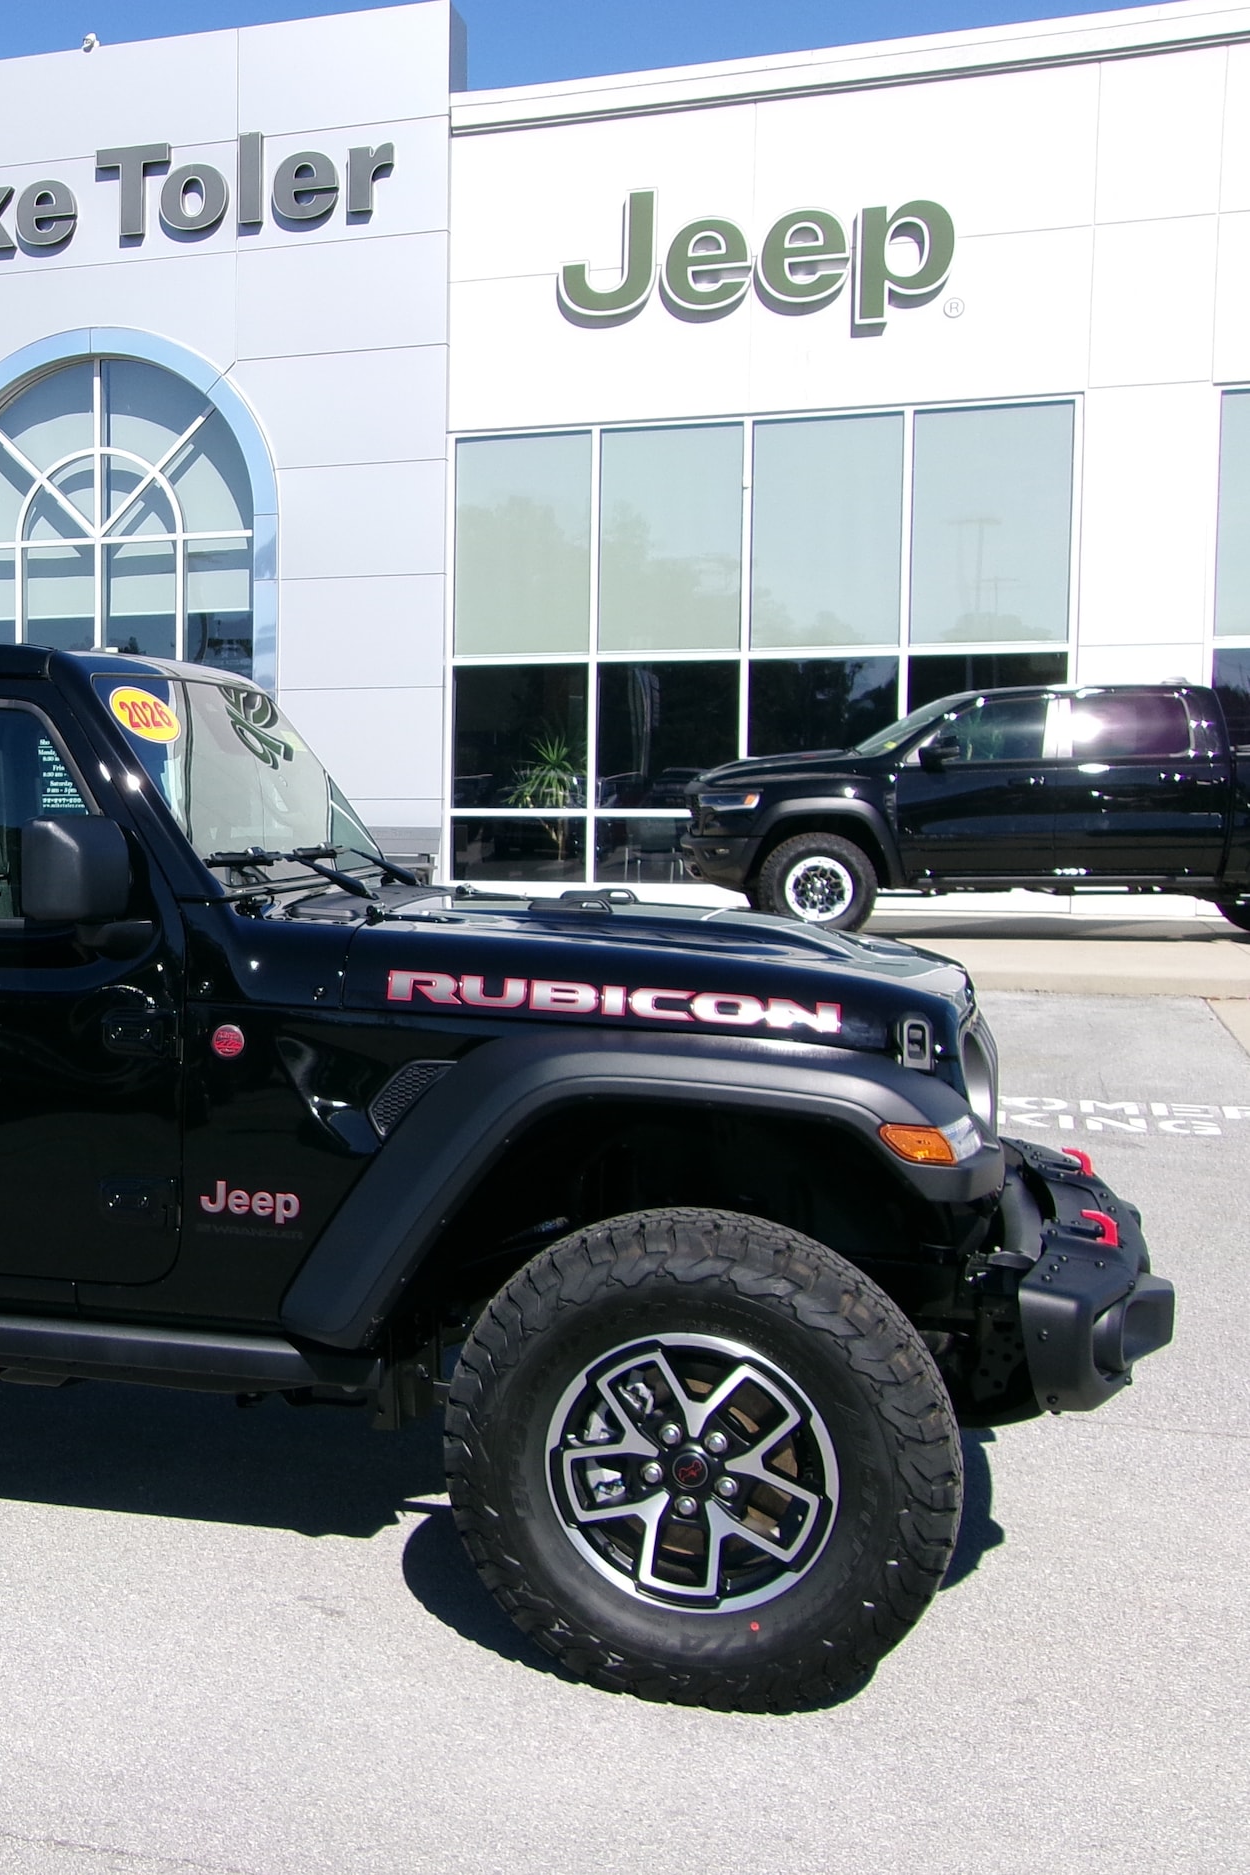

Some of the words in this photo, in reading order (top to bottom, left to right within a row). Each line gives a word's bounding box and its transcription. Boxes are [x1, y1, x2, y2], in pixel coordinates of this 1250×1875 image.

[95, 132, 395, 242] Toler
[556, 187, 955, 338] Jeep
[119, 701, 173, 729] 2026
[387, 969, 842, 1034] RUBICON
[200, 1180, 300, 1225] Jeep
